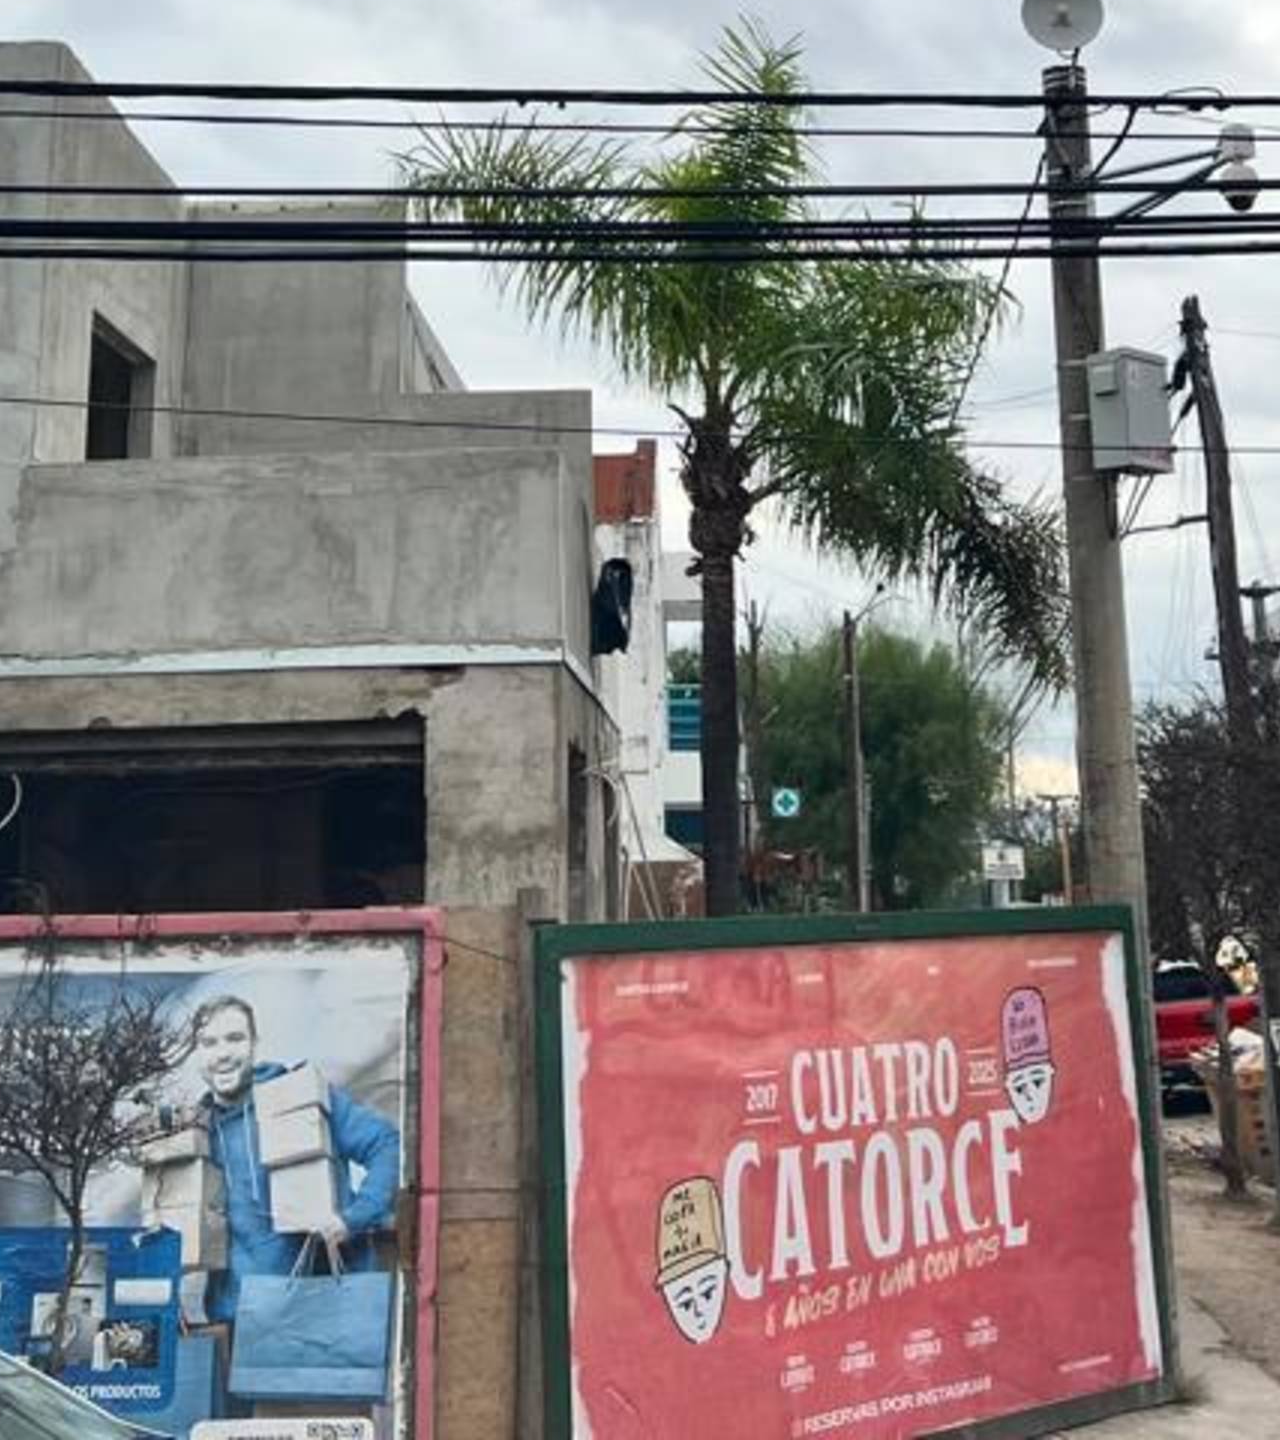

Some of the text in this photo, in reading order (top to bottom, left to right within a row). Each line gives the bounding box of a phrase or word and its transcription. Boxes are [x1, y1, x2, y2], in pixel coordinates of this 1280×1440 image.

[791, 1037, 959, 1134] CUATRO
[722, 1108, 1029, 1300] CATORCE
[783, 1283, 840, 1329] AÑOS
[846, 1272, 872, 1310] EN
[90, 1385, 161, 1399] PRODUCTOS
[803, 1402, 879, 1434] RESERVAS
[880, 1391, 915, 1417] POR
